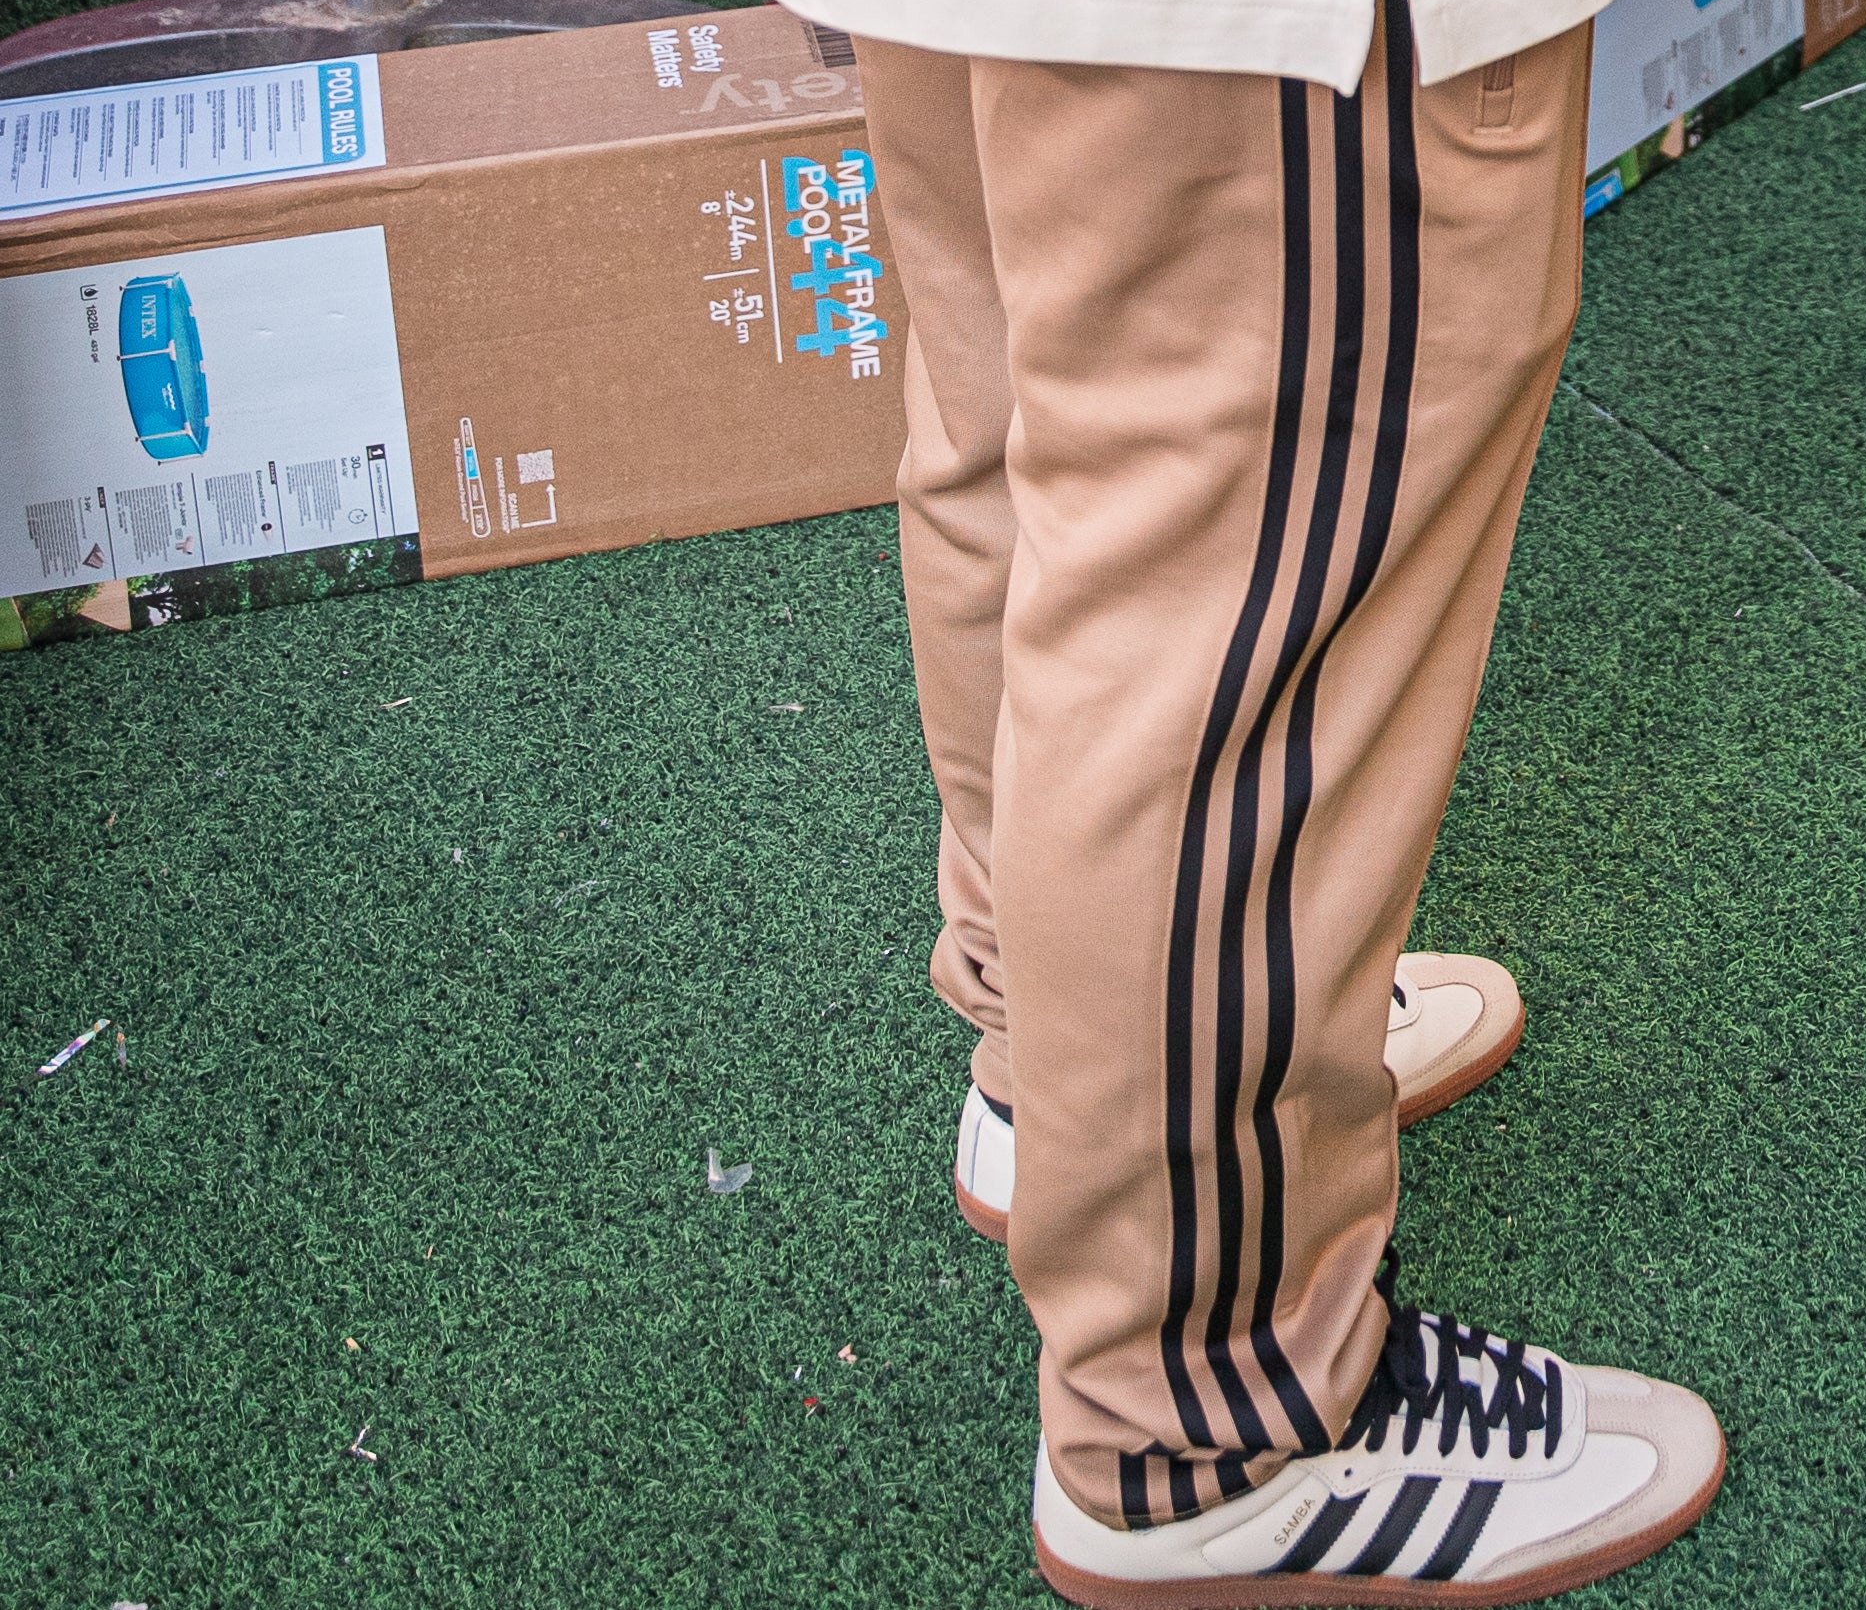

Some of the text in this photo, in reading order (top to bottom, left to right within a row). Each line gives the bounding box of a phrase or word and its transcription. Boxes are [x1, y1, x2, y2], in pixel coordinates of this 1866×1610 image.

[687, 24, 724, 73] Safety
[327, 67, 354, 109] POOL
[698, 71, 864, 115] ety
[836, 157, 882, 380] METAL FRAME
[86, 304, 99, 336] 1828L
[141, 294, 156, 339] INTEX
[508, 492, 520, 530] SCAN ME
[1273, 1498, 1316, 1545] SAMBA
